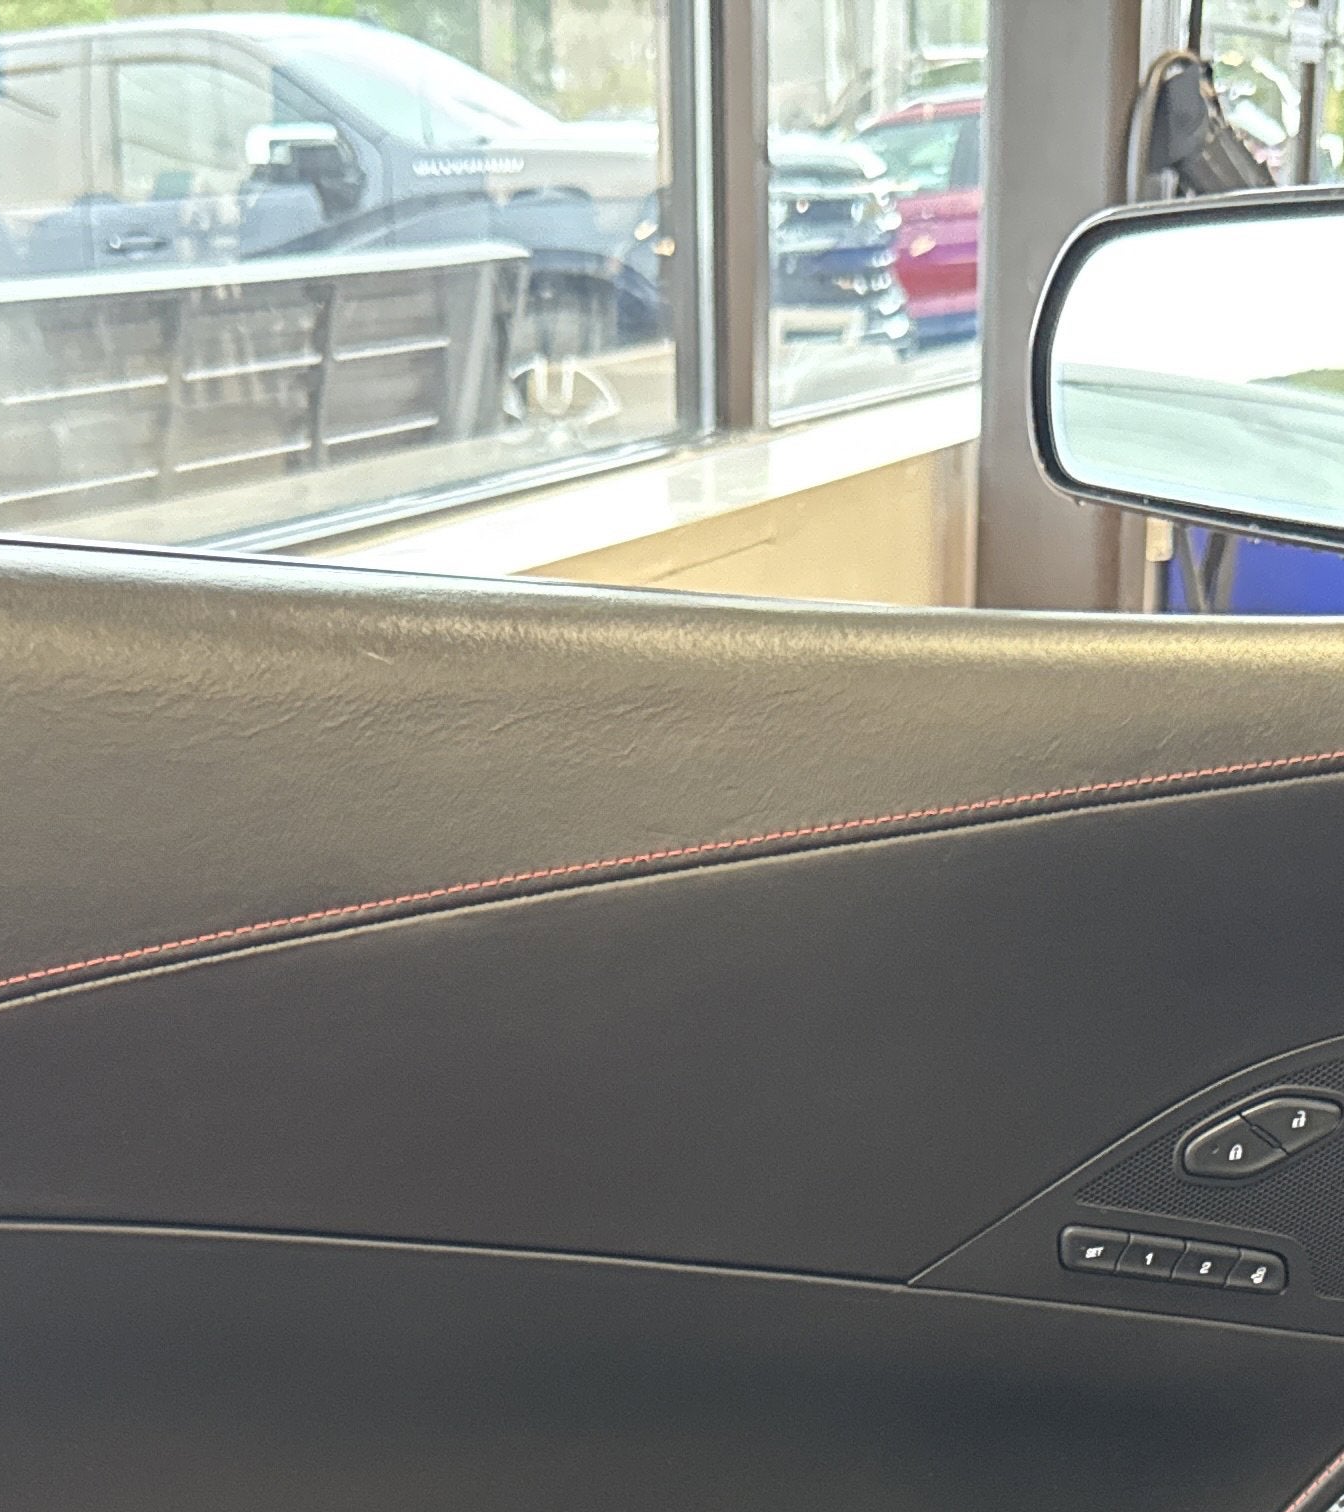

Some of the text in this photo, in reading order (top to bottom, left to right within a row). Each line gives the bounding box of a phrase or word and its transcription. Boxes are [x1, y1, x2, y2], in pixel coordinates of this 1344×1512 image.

[1085, 1247, 1212, 1274] SET 1 2
